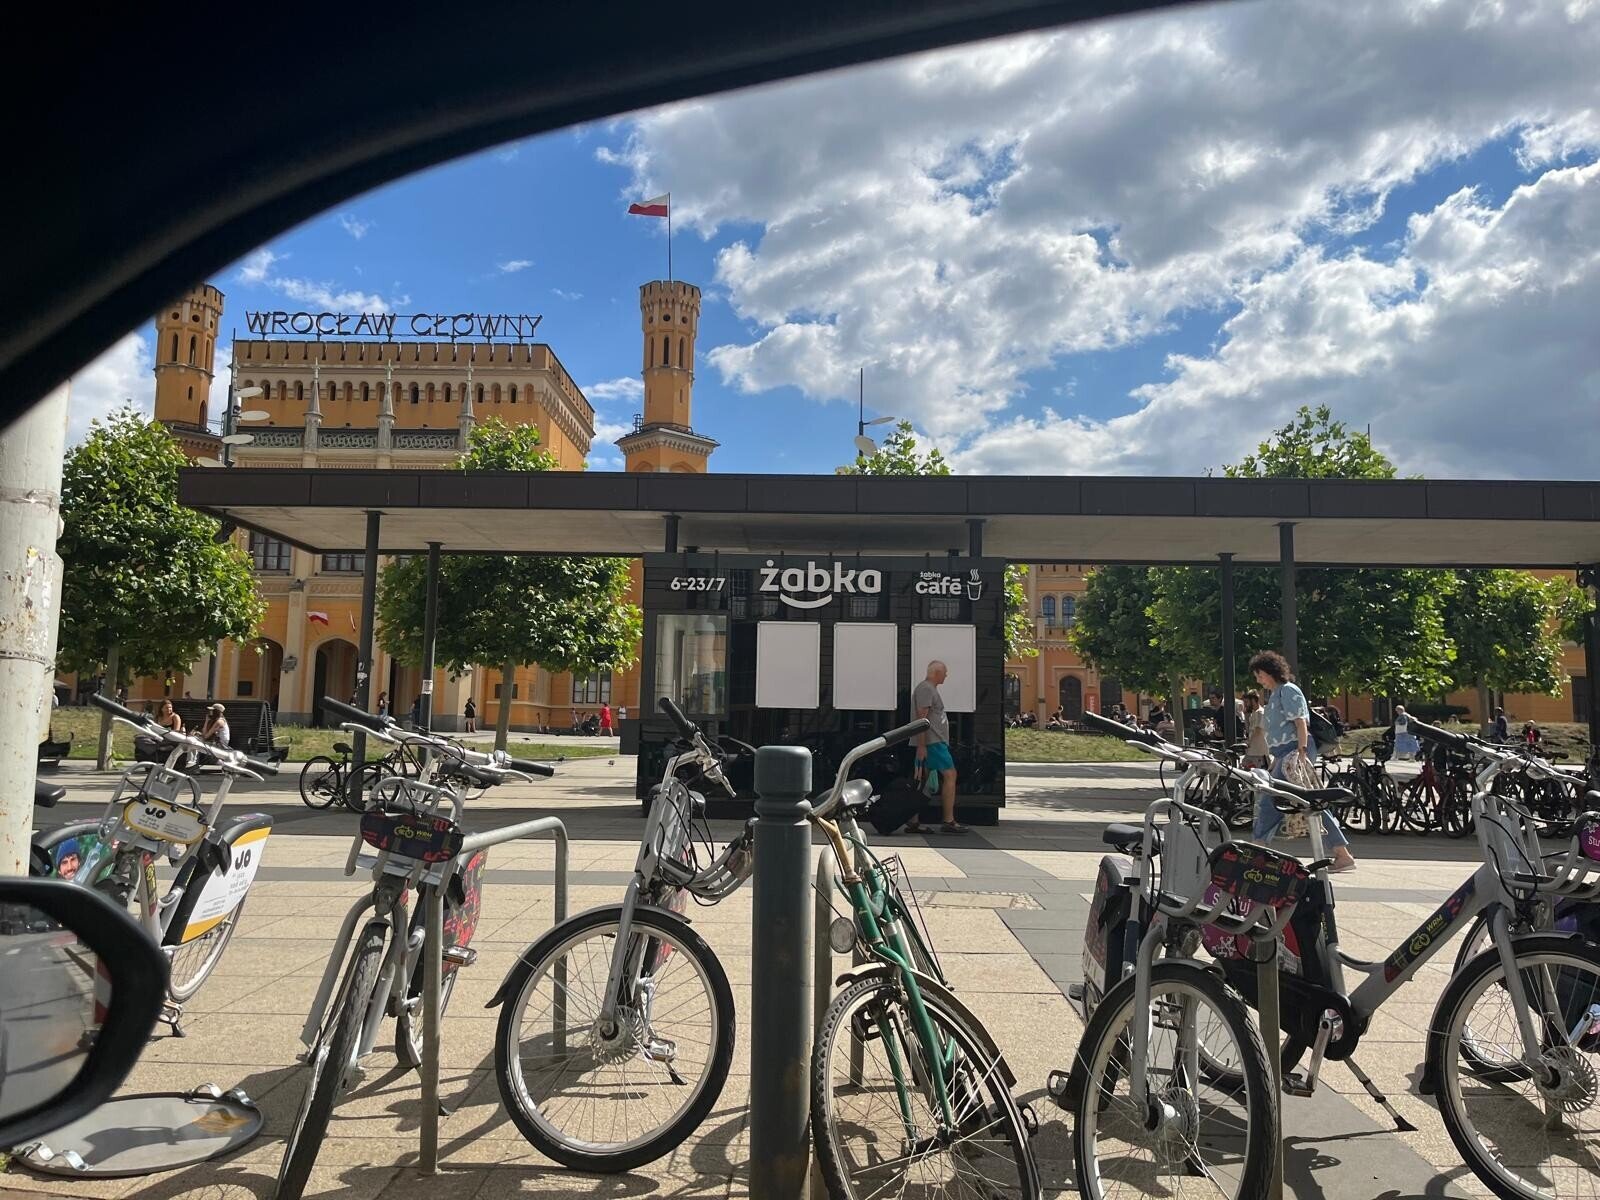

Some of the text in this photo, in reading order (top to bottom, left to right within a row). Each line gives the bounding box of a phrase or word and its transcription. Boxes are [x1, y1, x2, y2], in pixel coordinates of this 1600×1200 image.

[245, 311, 543, 337] WROCŁAW GŁÓWNY
[670, 577, 726, 591] 6-23/7
[759, 560, 882, 594] żabka
